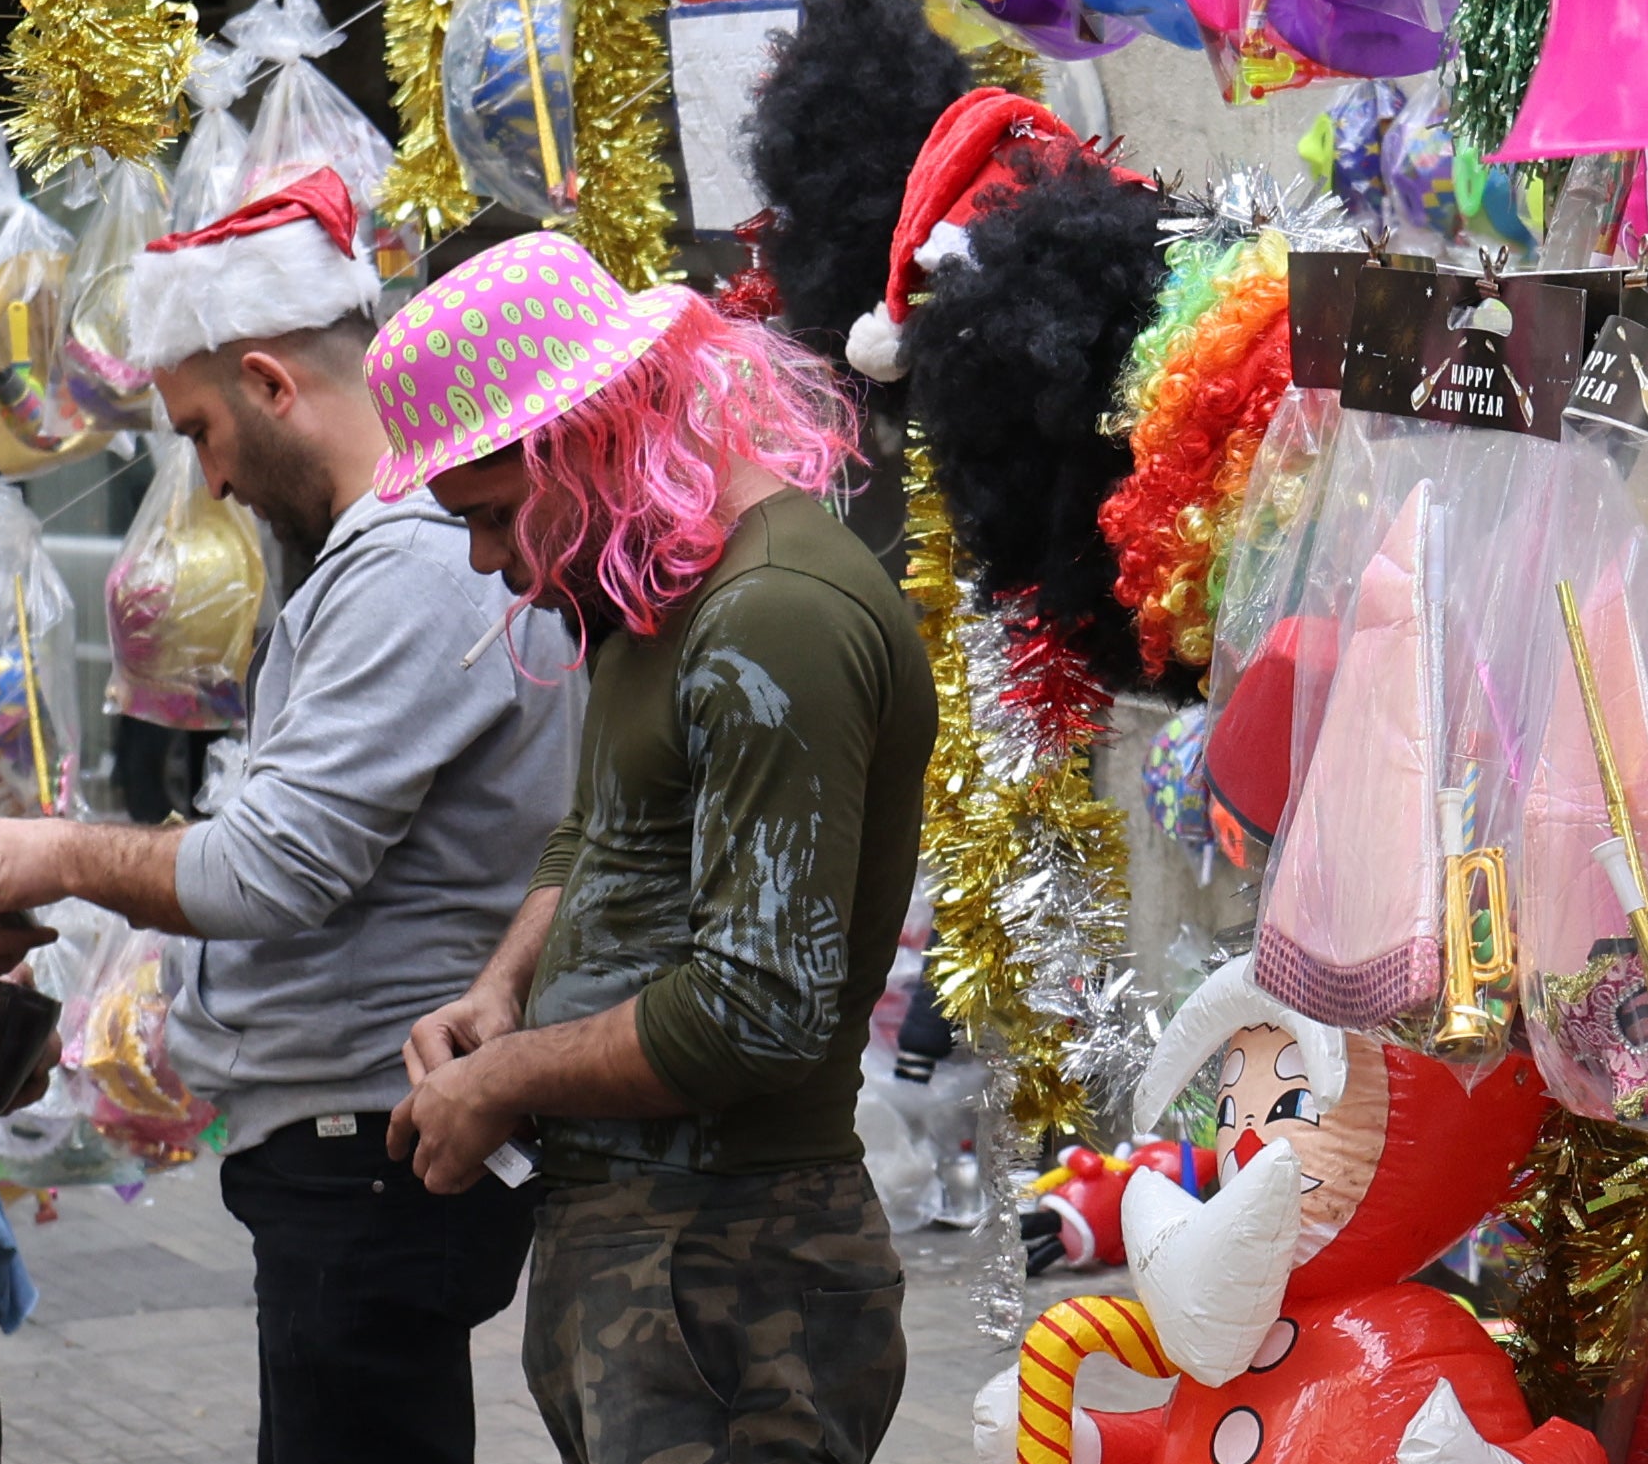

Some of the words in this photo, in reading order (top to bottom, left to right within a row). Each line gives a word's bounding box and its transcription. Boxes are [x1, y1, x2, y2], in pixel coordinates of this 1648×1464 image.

[1582, 350, 1618, 374] PPY
[1450, 363, 1494, 389] HAPPY
[1440, 389, 1464, 412] NEW
[1468, 392, 1504, 418] YEAR
[1575, 375, 1618, 405] YEAR
